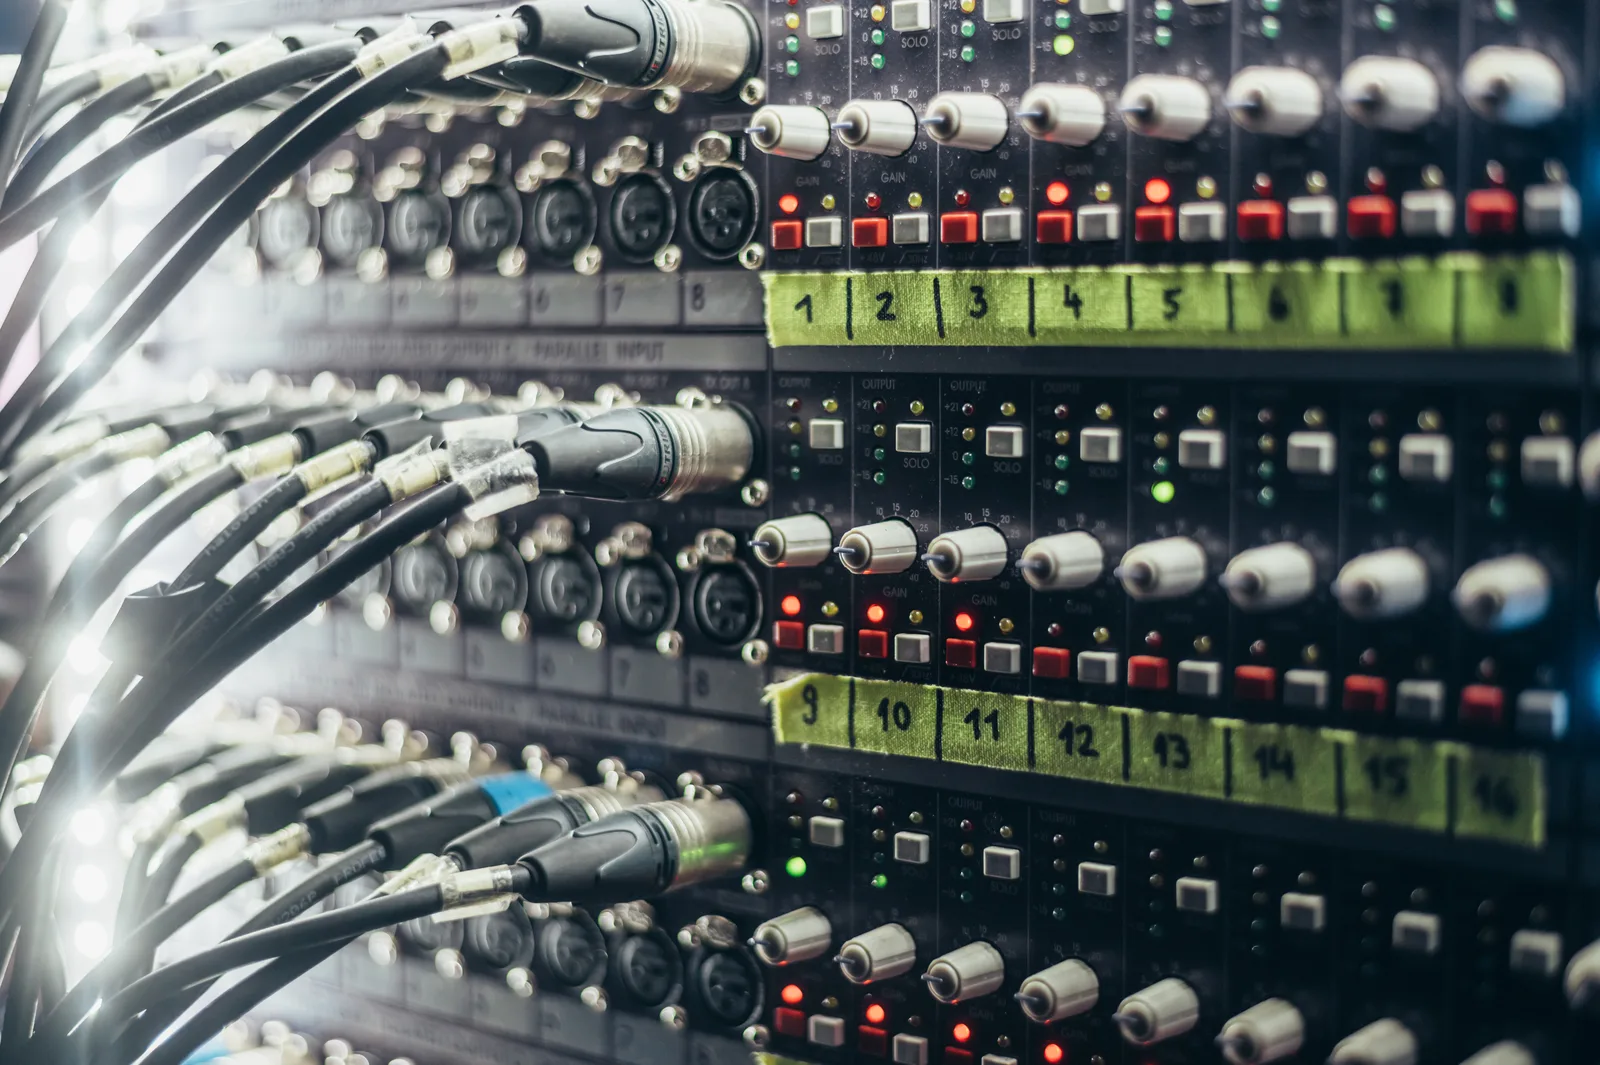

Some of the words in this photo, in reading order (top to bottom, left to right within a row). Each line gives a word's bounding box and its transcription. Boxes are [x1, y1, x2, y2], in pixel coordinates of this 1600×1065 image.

[854, 8, 869, 19] +12
[951, 25, 958, 35] 0
[992, 28, 1021, 41] SOLO
[862, 32, 869, 43] 0
[901, 35, 929, 49] SOLO
[815, 43, 841, 56] SOLO
[890, 85, 899, 94] 15
[981, 79, 989, 88] 15
[1000, 83, 1010, 92] 20
[908, 88, 918, 98] 20
[918, 142, 928, 151] 35
[908, 155, 918, 164] 40
[880, 172, 906, 184] GAIN
[970, 168, 997, 180] GAIN
[795, 176, 820, 187] GAIN
[611, 282, 626, 314] 7
[690, 282, 706, 313] 8
[970, 286, 988, 320] 3
[1063, 284, 1082, 321] 4
[1161, 285, 1183, 322] 5
[794, 294, 813, 325] 1
[876, 291, 896, 322] 2
[861, 379, 896, 391] OUTPUT
[950, 380, 987, 392] OUTPUT
[857, 401, 871, 411] +21
[944, 403, 959, 412] +21
[944, 428, 959, 437] +12
[903, 457, 930, 469] SOLO
[994, 462, 1022, 474] SOLO
[944, 475, 959, 485] -15
[876, 507, 883, 516] 10
[892, 503, 900, 511] 15
[982, 508, 990, 517] 15
[910, 509, 920, 518] 20
[964, 512, 972, 521] 10
[1000, 515, 1010, 524] 20
[919, 523, 929, 532] 25
[909, 573, 919, 582] 40
[883, 586, 908, 598] GAIN
[971, 594, 997, 607] GAIN
[800, 684, 819, 726] 9
[877, 696, 911, 732] 10
[963, 707, 1000, 741] 11
[1058, 719, 1099, 757] 12
[1154, 730, 1190, 770] 13
[1255, 743, 1296, 783] 14
[1363, 752, 1410, 796] 15
